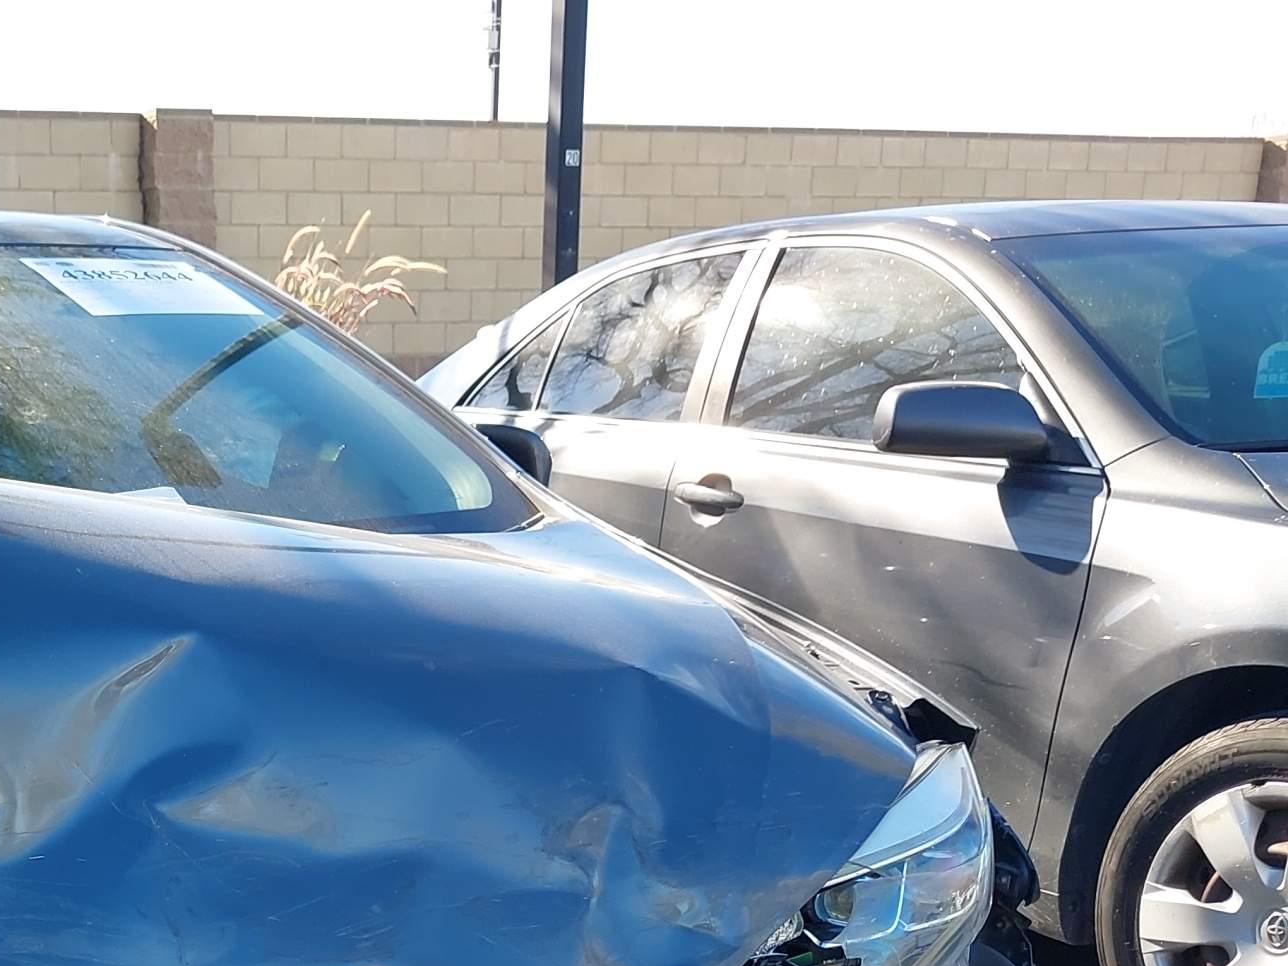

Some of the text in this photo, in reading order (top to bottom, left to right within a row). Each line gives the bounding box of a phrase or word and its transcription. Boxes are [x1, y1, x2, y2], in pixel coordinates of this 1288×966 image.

[567, 152, 578, 165] 20
[63, 269, 193, 282] 43852644
[1141, 747, 1239, 817] SUMMIT
